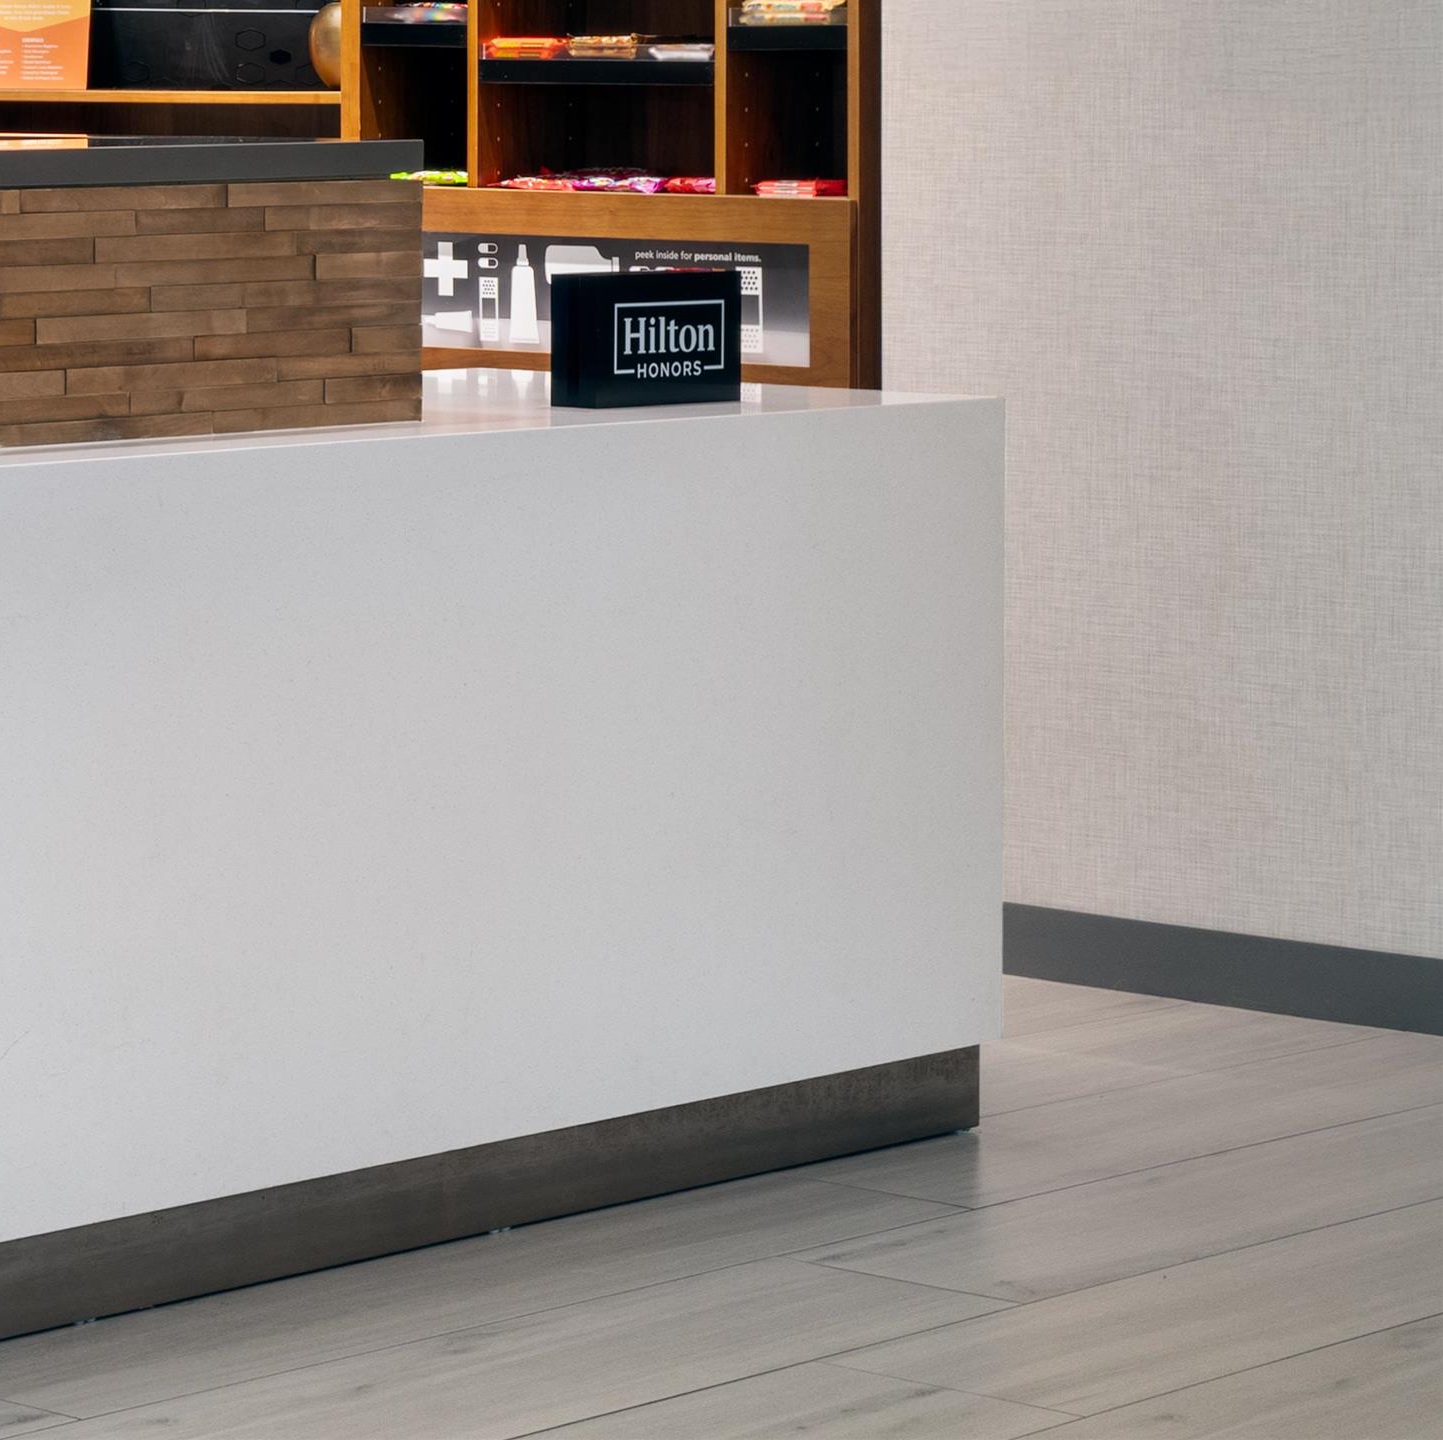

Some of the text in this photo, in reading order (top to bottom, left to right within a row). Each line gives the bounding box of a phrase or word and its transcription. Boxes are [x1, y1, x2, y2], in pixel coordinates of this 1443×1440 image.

[635, 249, 762, 262] peek inside for personal items.
[622, 316, 716, 356] Hilton
[636, 359, 703, 379] HONORS
